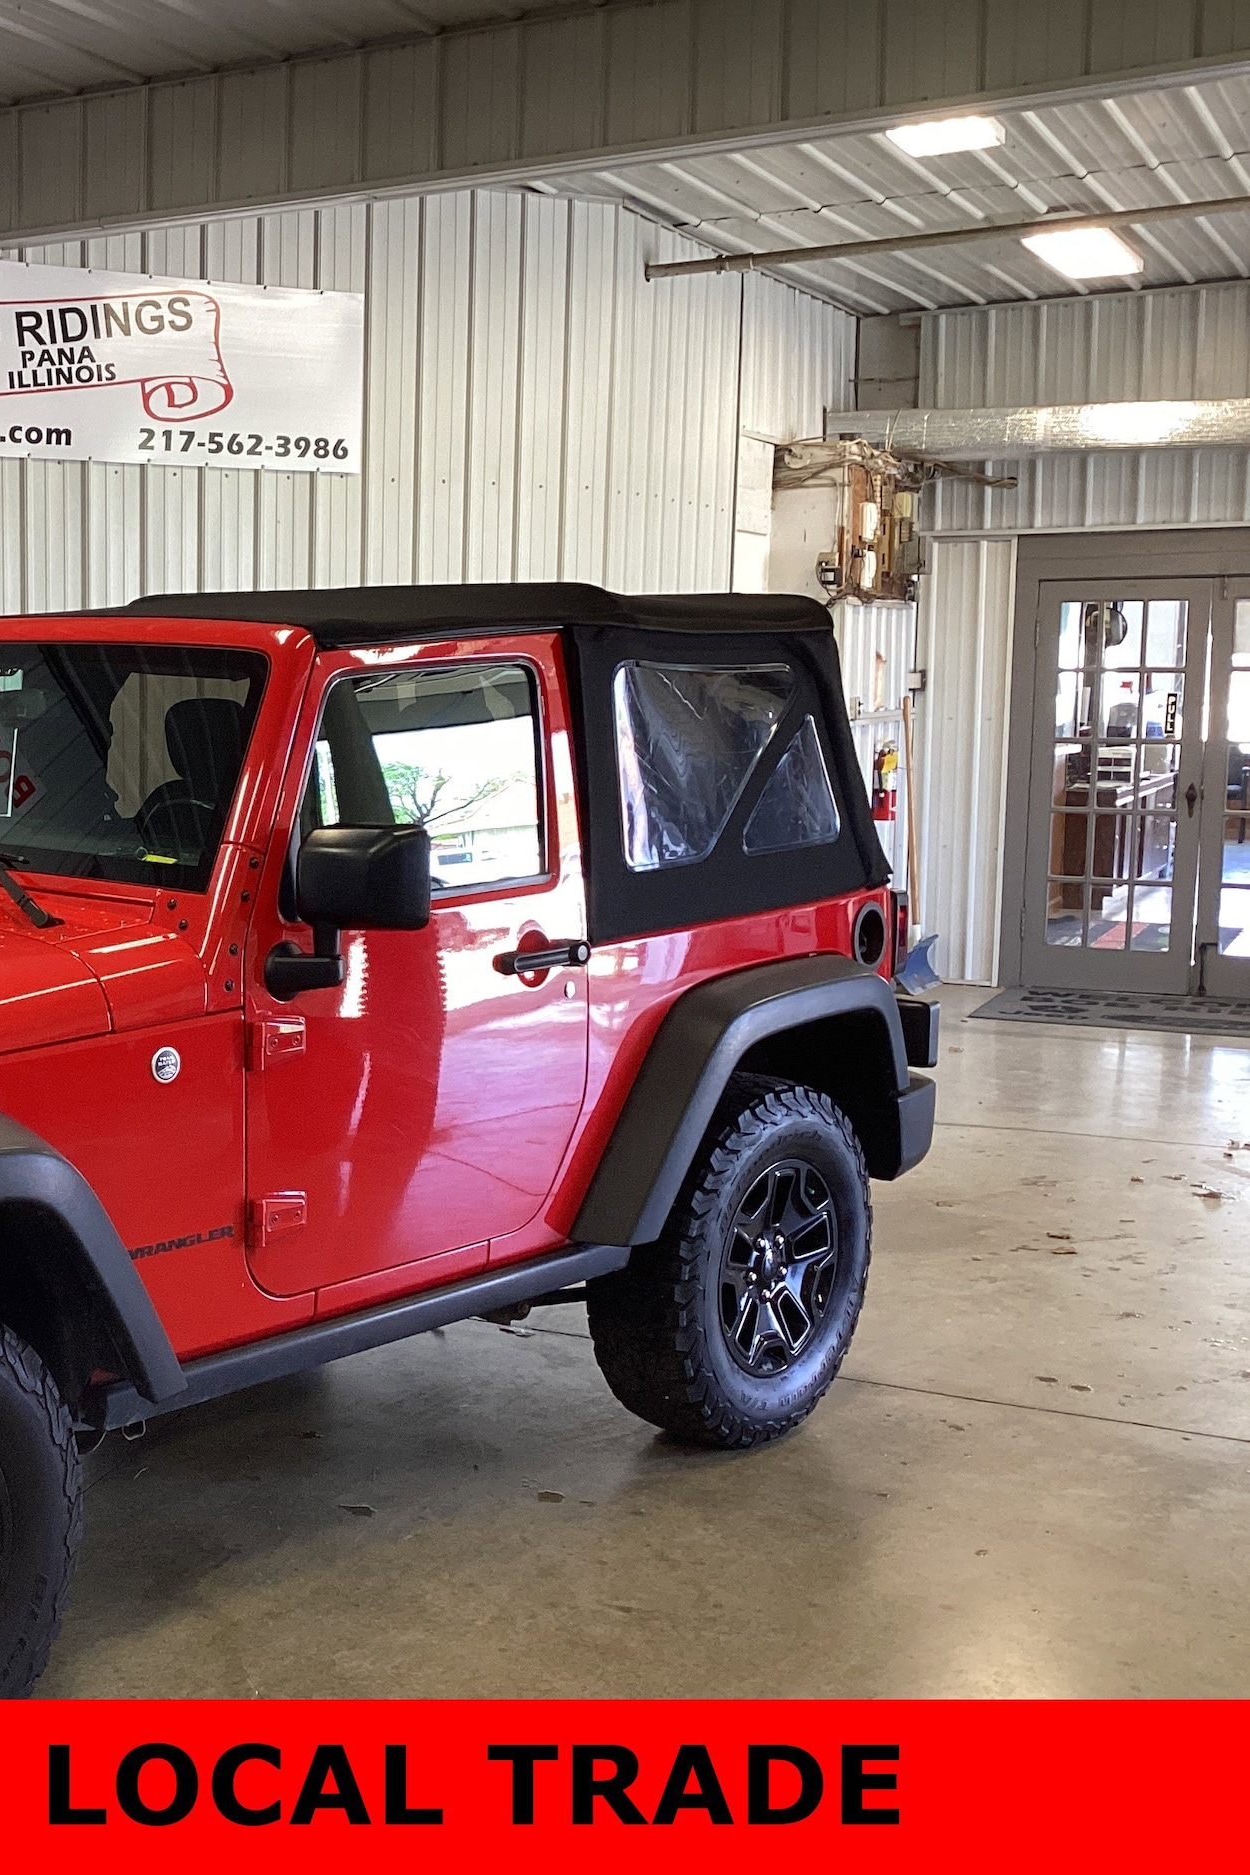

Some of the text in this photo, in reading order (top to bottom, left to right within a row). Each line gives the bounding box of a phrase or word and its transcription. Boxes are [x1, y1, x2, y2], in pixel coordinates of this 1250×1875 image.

[15, 297, 193, 347] RIDINGS
[21, 346, 96, 369] PANA
[8, 363, 116, 389] ILLINOIS
[138, 427, 349, 460] 217-562-3986
[1166, 696, 1176, 731] PULL
